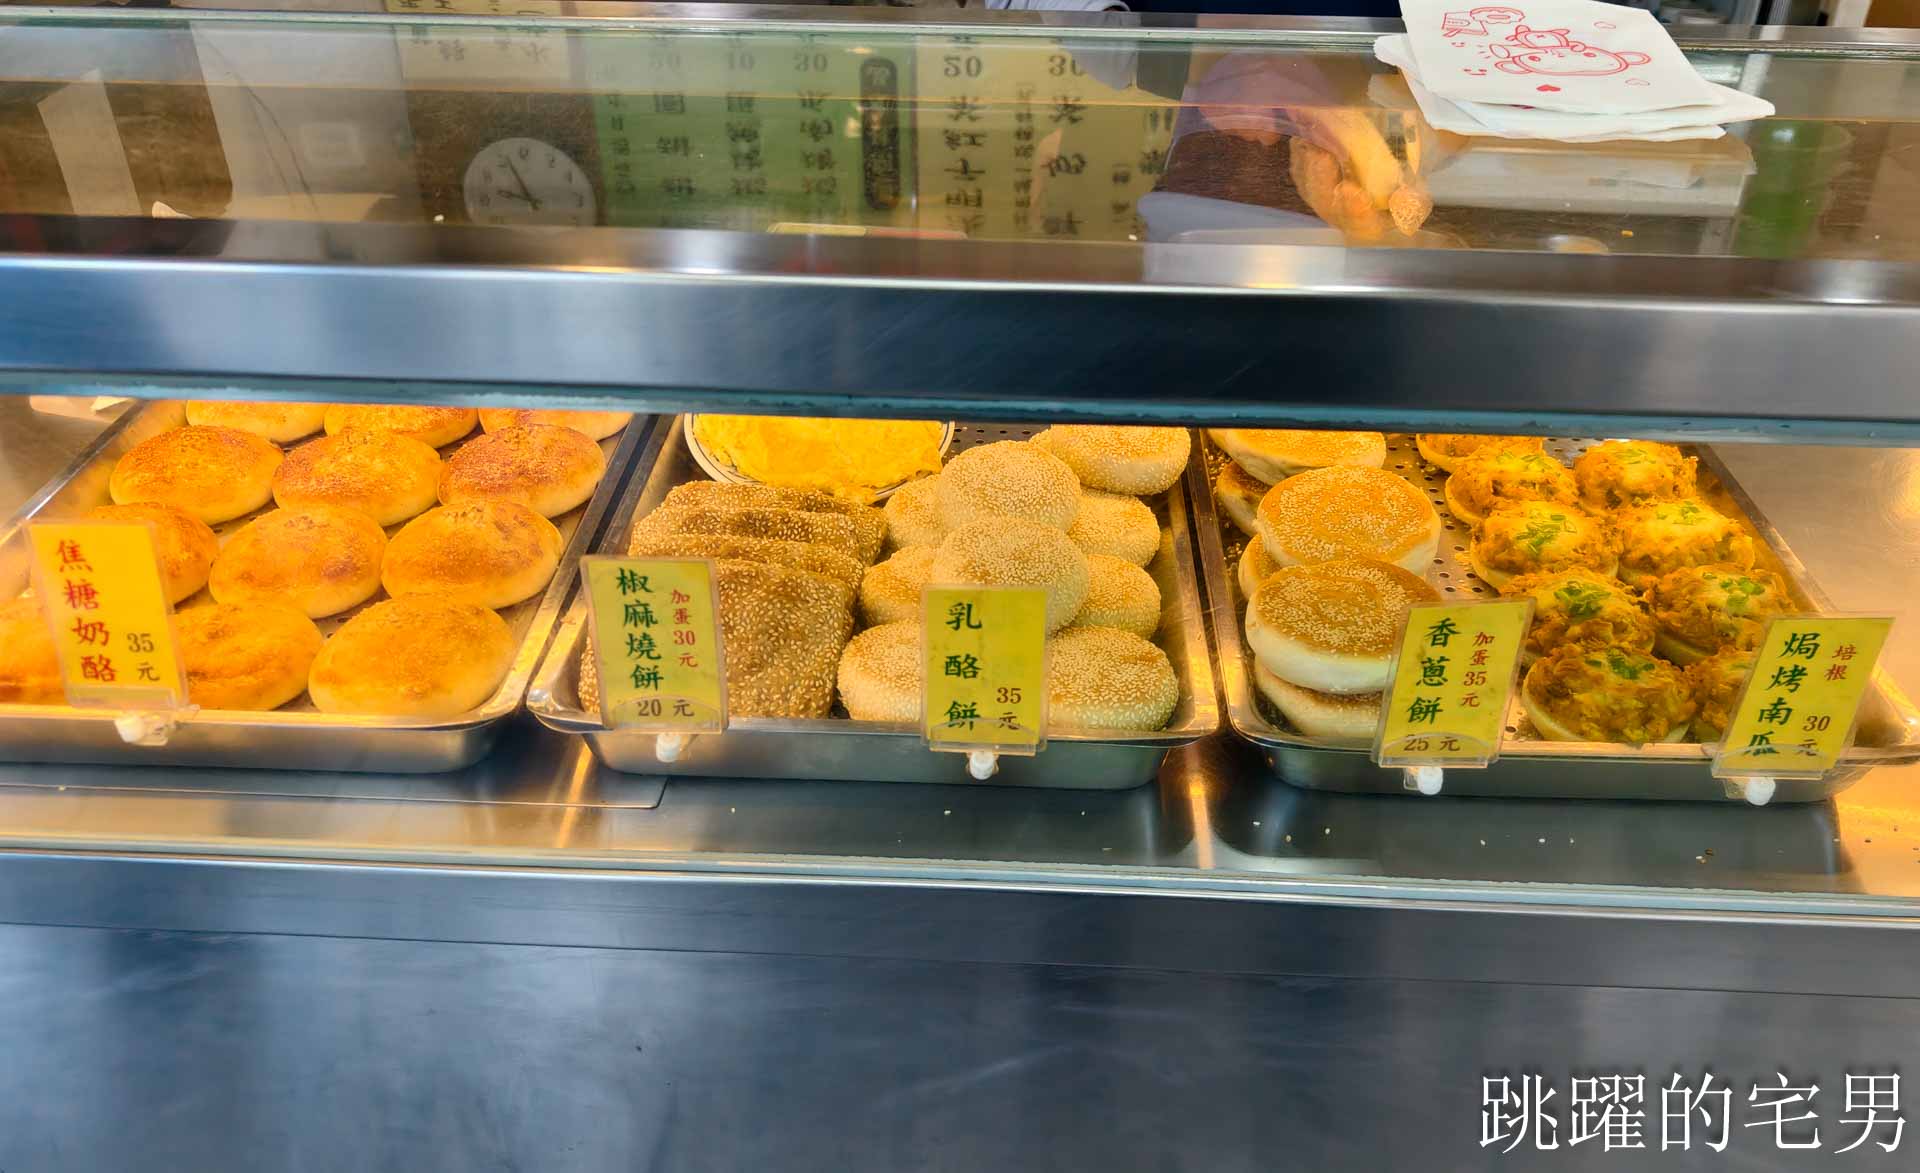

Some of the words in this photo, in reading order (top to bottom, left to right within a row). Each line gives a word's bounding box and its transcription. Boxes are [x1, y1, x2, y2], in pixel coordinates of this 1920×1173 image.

[57, 539, 117, 682] 焦糖奶酪
[616, 567, 664, 691] 椒麻燒餅
[671, 589, 698, 668] 加蛋30元
[944, 602, 983, 731] 乳酪餅
[1824, 644, 1857, 681] 培根
[1407, 618, 1461, 724] 香蔥餅
[1460, 631, 1495, 707] 加蛋35元
[1742, 632, 1821, 756] 焗烤南瓜
